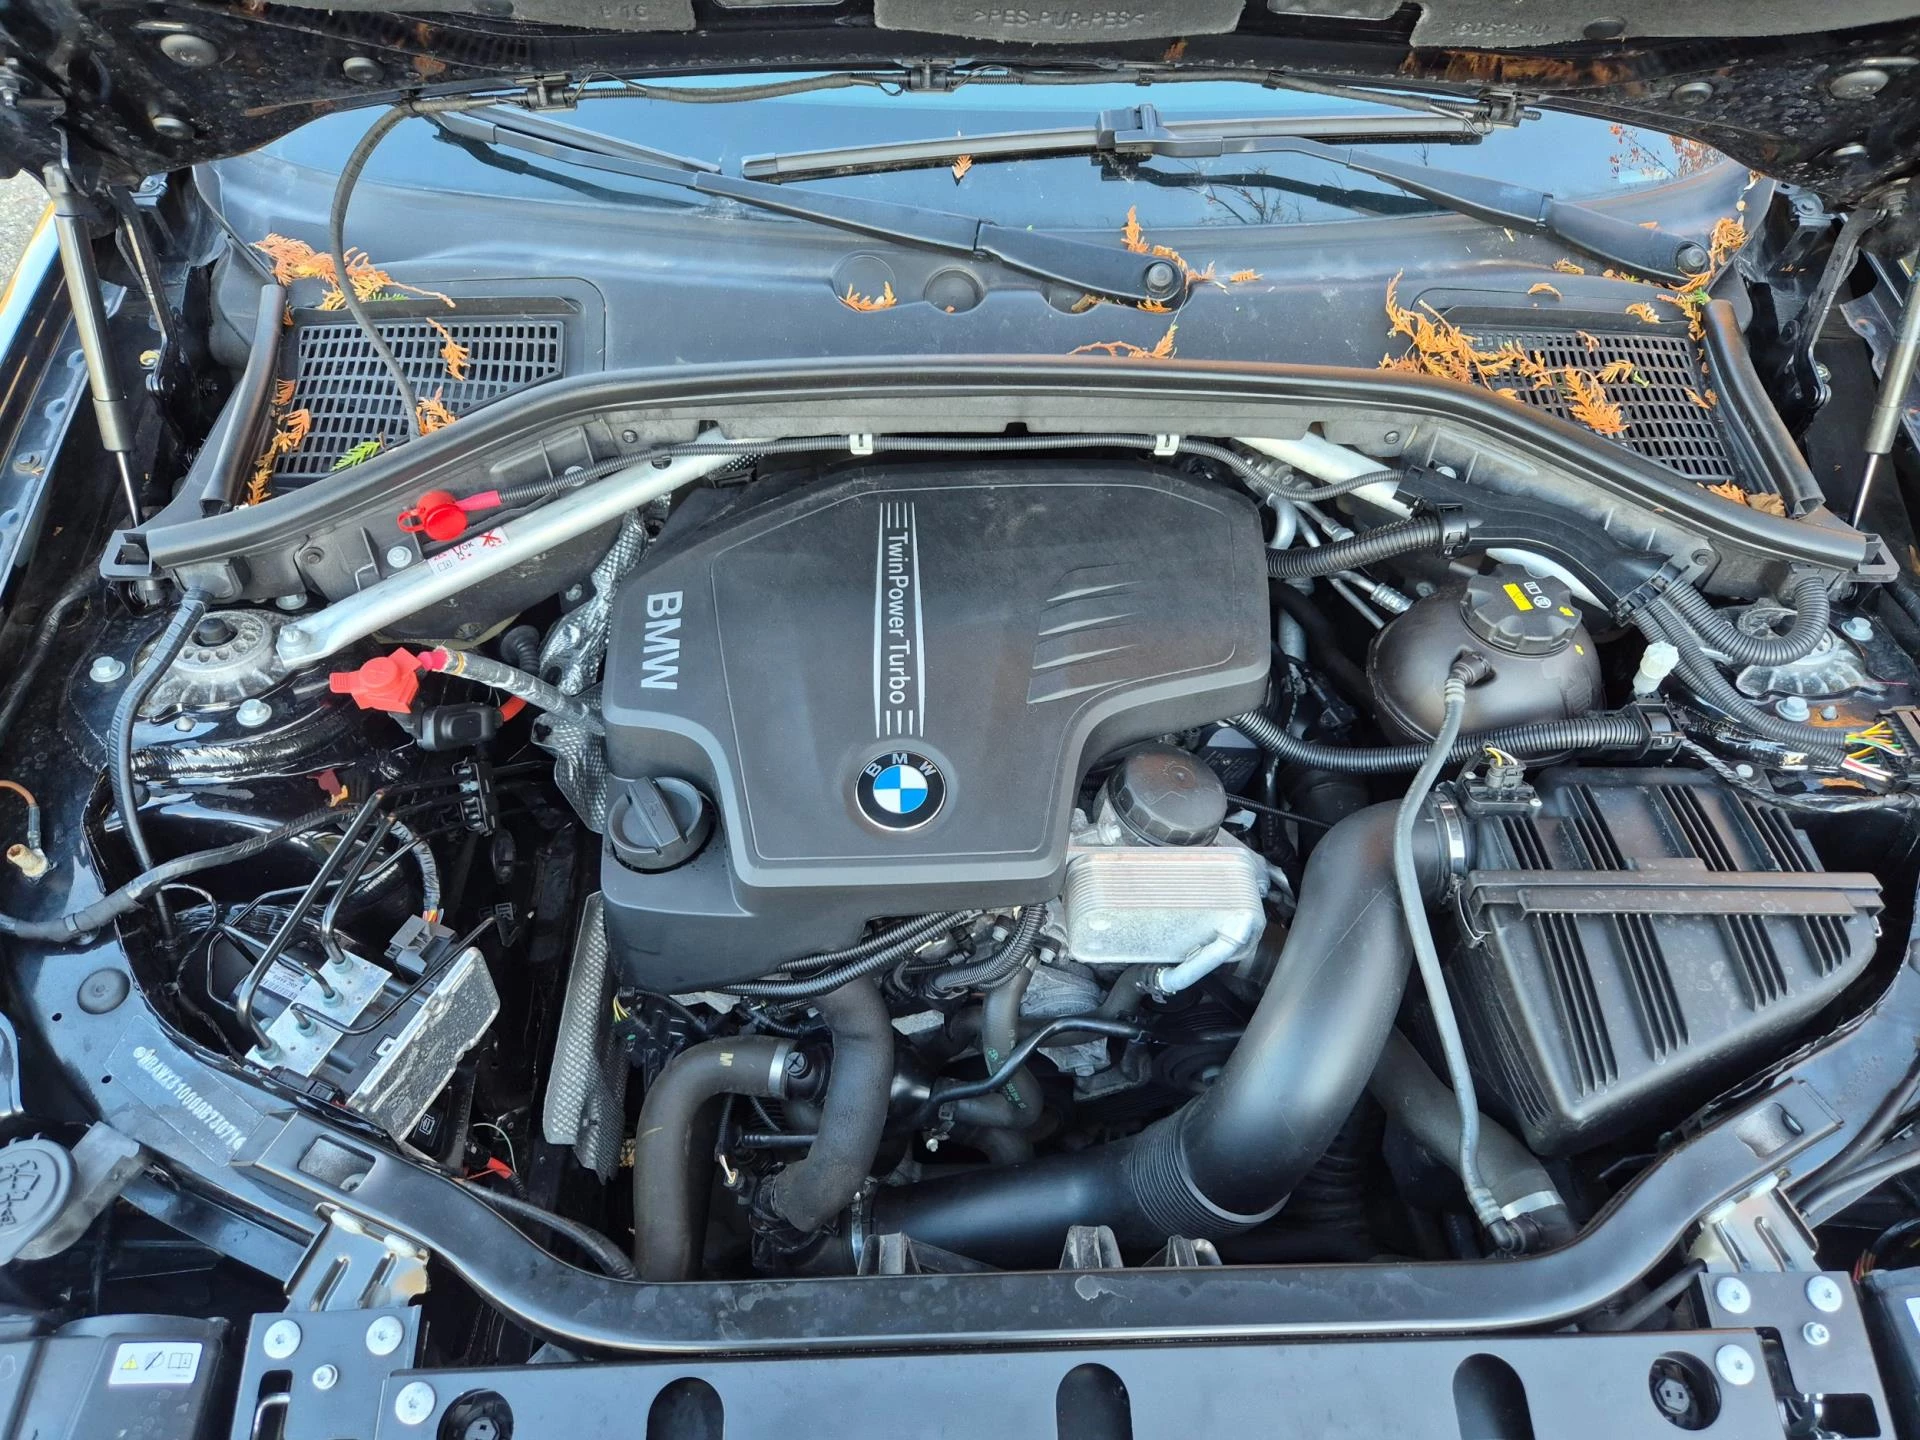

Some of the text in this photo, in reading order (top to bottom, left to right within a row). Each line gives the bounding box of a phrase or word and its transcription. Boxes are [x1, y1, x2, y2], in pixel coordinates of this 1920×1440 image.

[461, 541, 475, 551] OK
[640, 590, 684, 690] BMW
[888, 531, 912, 705] TwinPower Turbo
[865, 753, 937, 778] BMW
